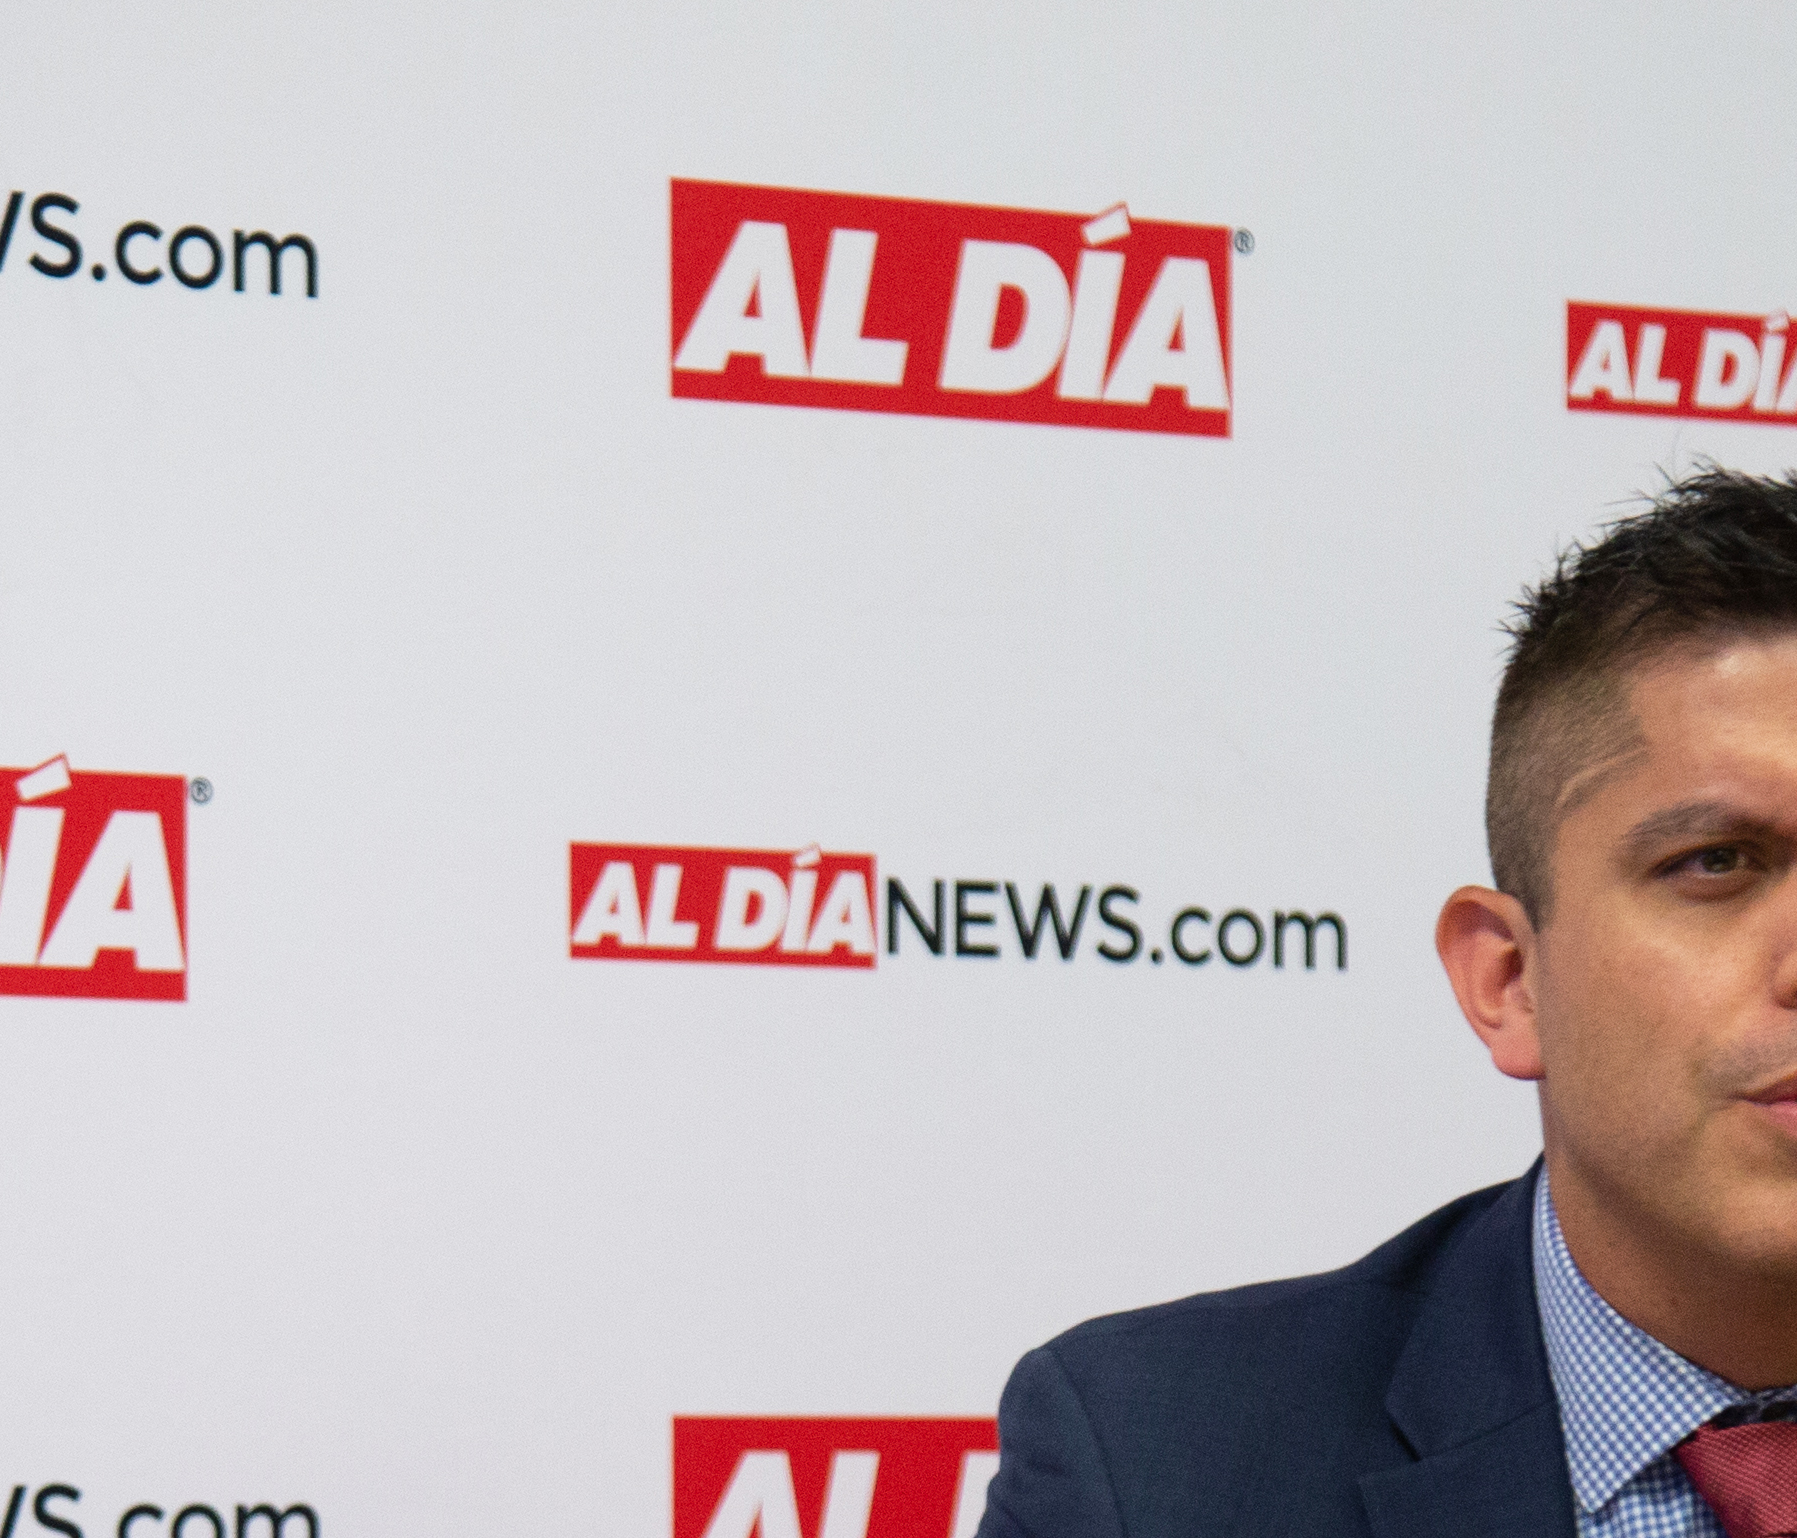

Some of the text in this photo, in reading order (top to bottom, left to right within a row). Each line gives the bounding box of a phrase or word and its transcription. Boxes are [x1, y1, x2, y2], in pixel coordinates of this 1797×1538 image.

[674, 220, 910, 386] AL
[938, 202, 1229, 411] DÍA
[1570, 319, 1681, 408] AL
[571, 861, 698, 948] AL
